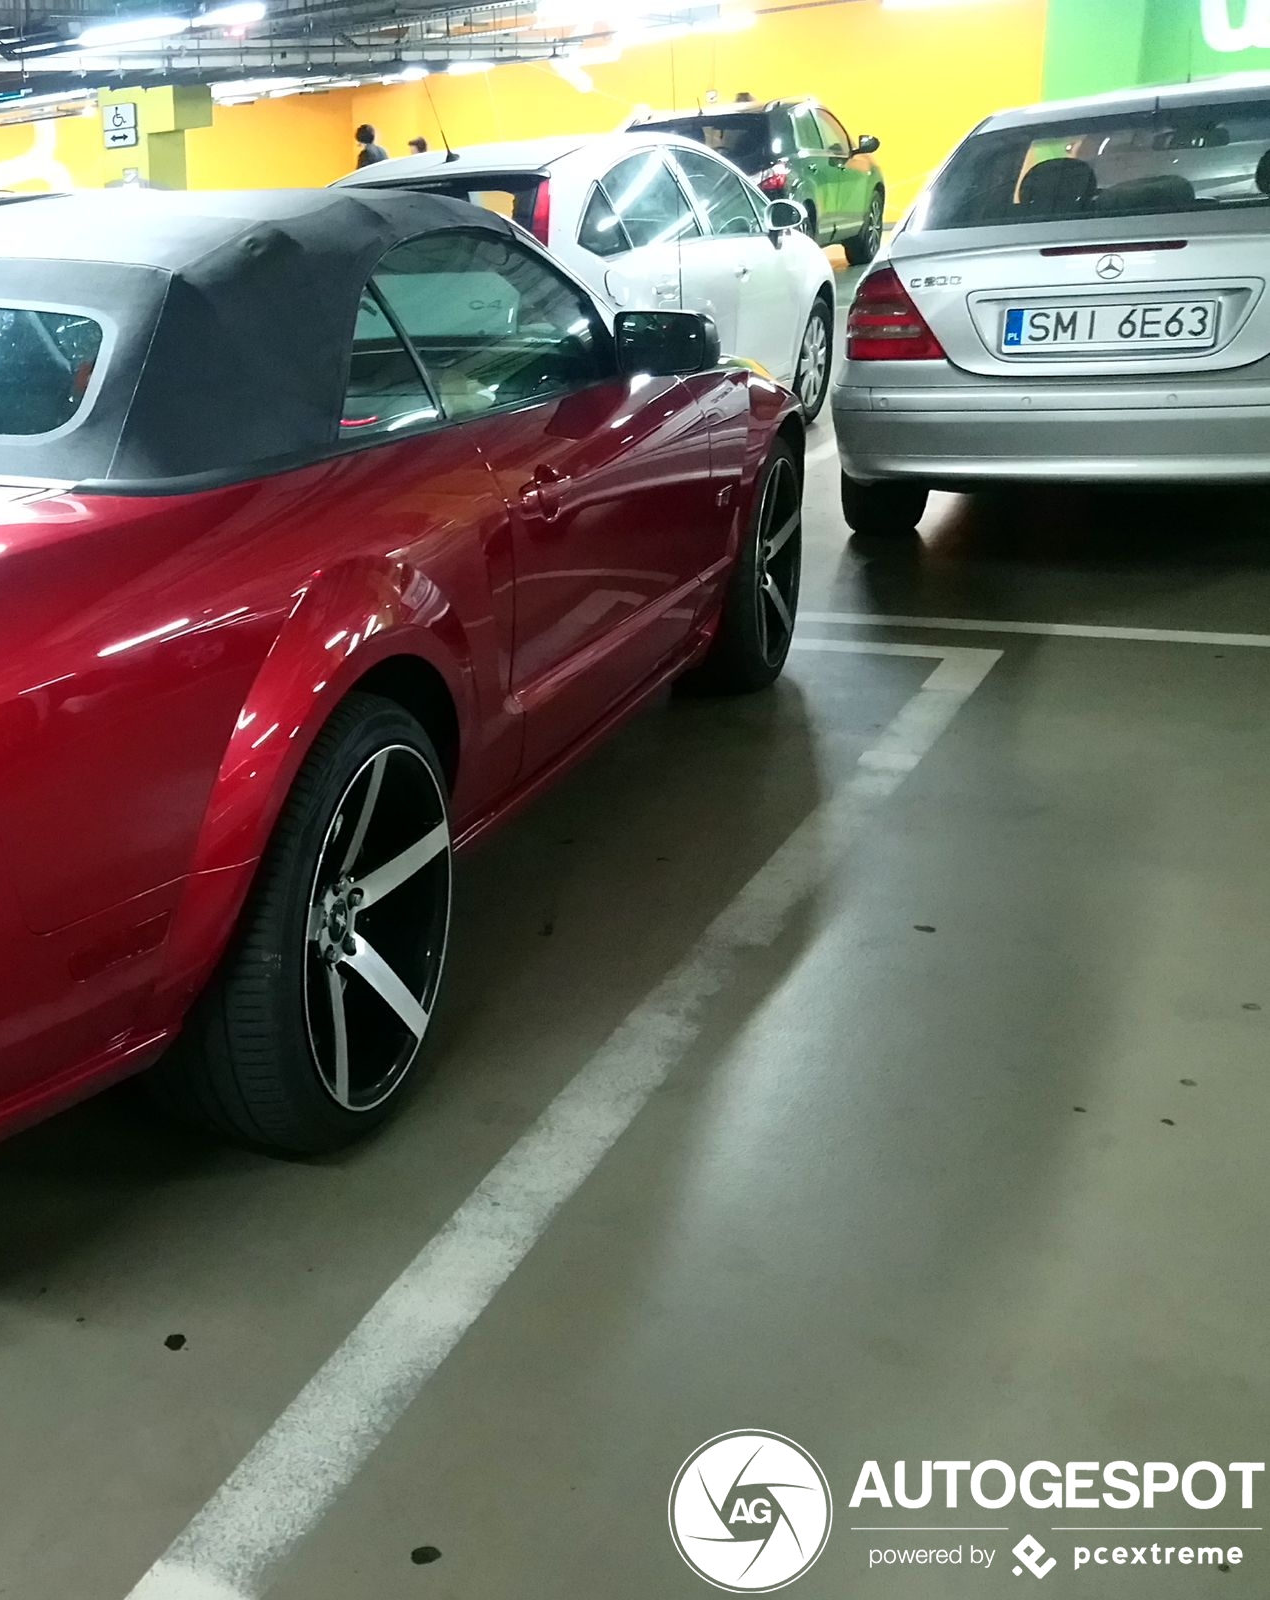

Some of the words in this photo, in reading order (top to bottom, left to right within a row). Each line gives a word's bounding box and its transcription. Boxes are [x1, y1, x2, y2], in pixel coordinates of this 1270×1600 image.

[1027, 310, 1096, 342] SMI
[1117, 306, 1209, 339] 6E63
[1007, 332, 1019, 342] PL
